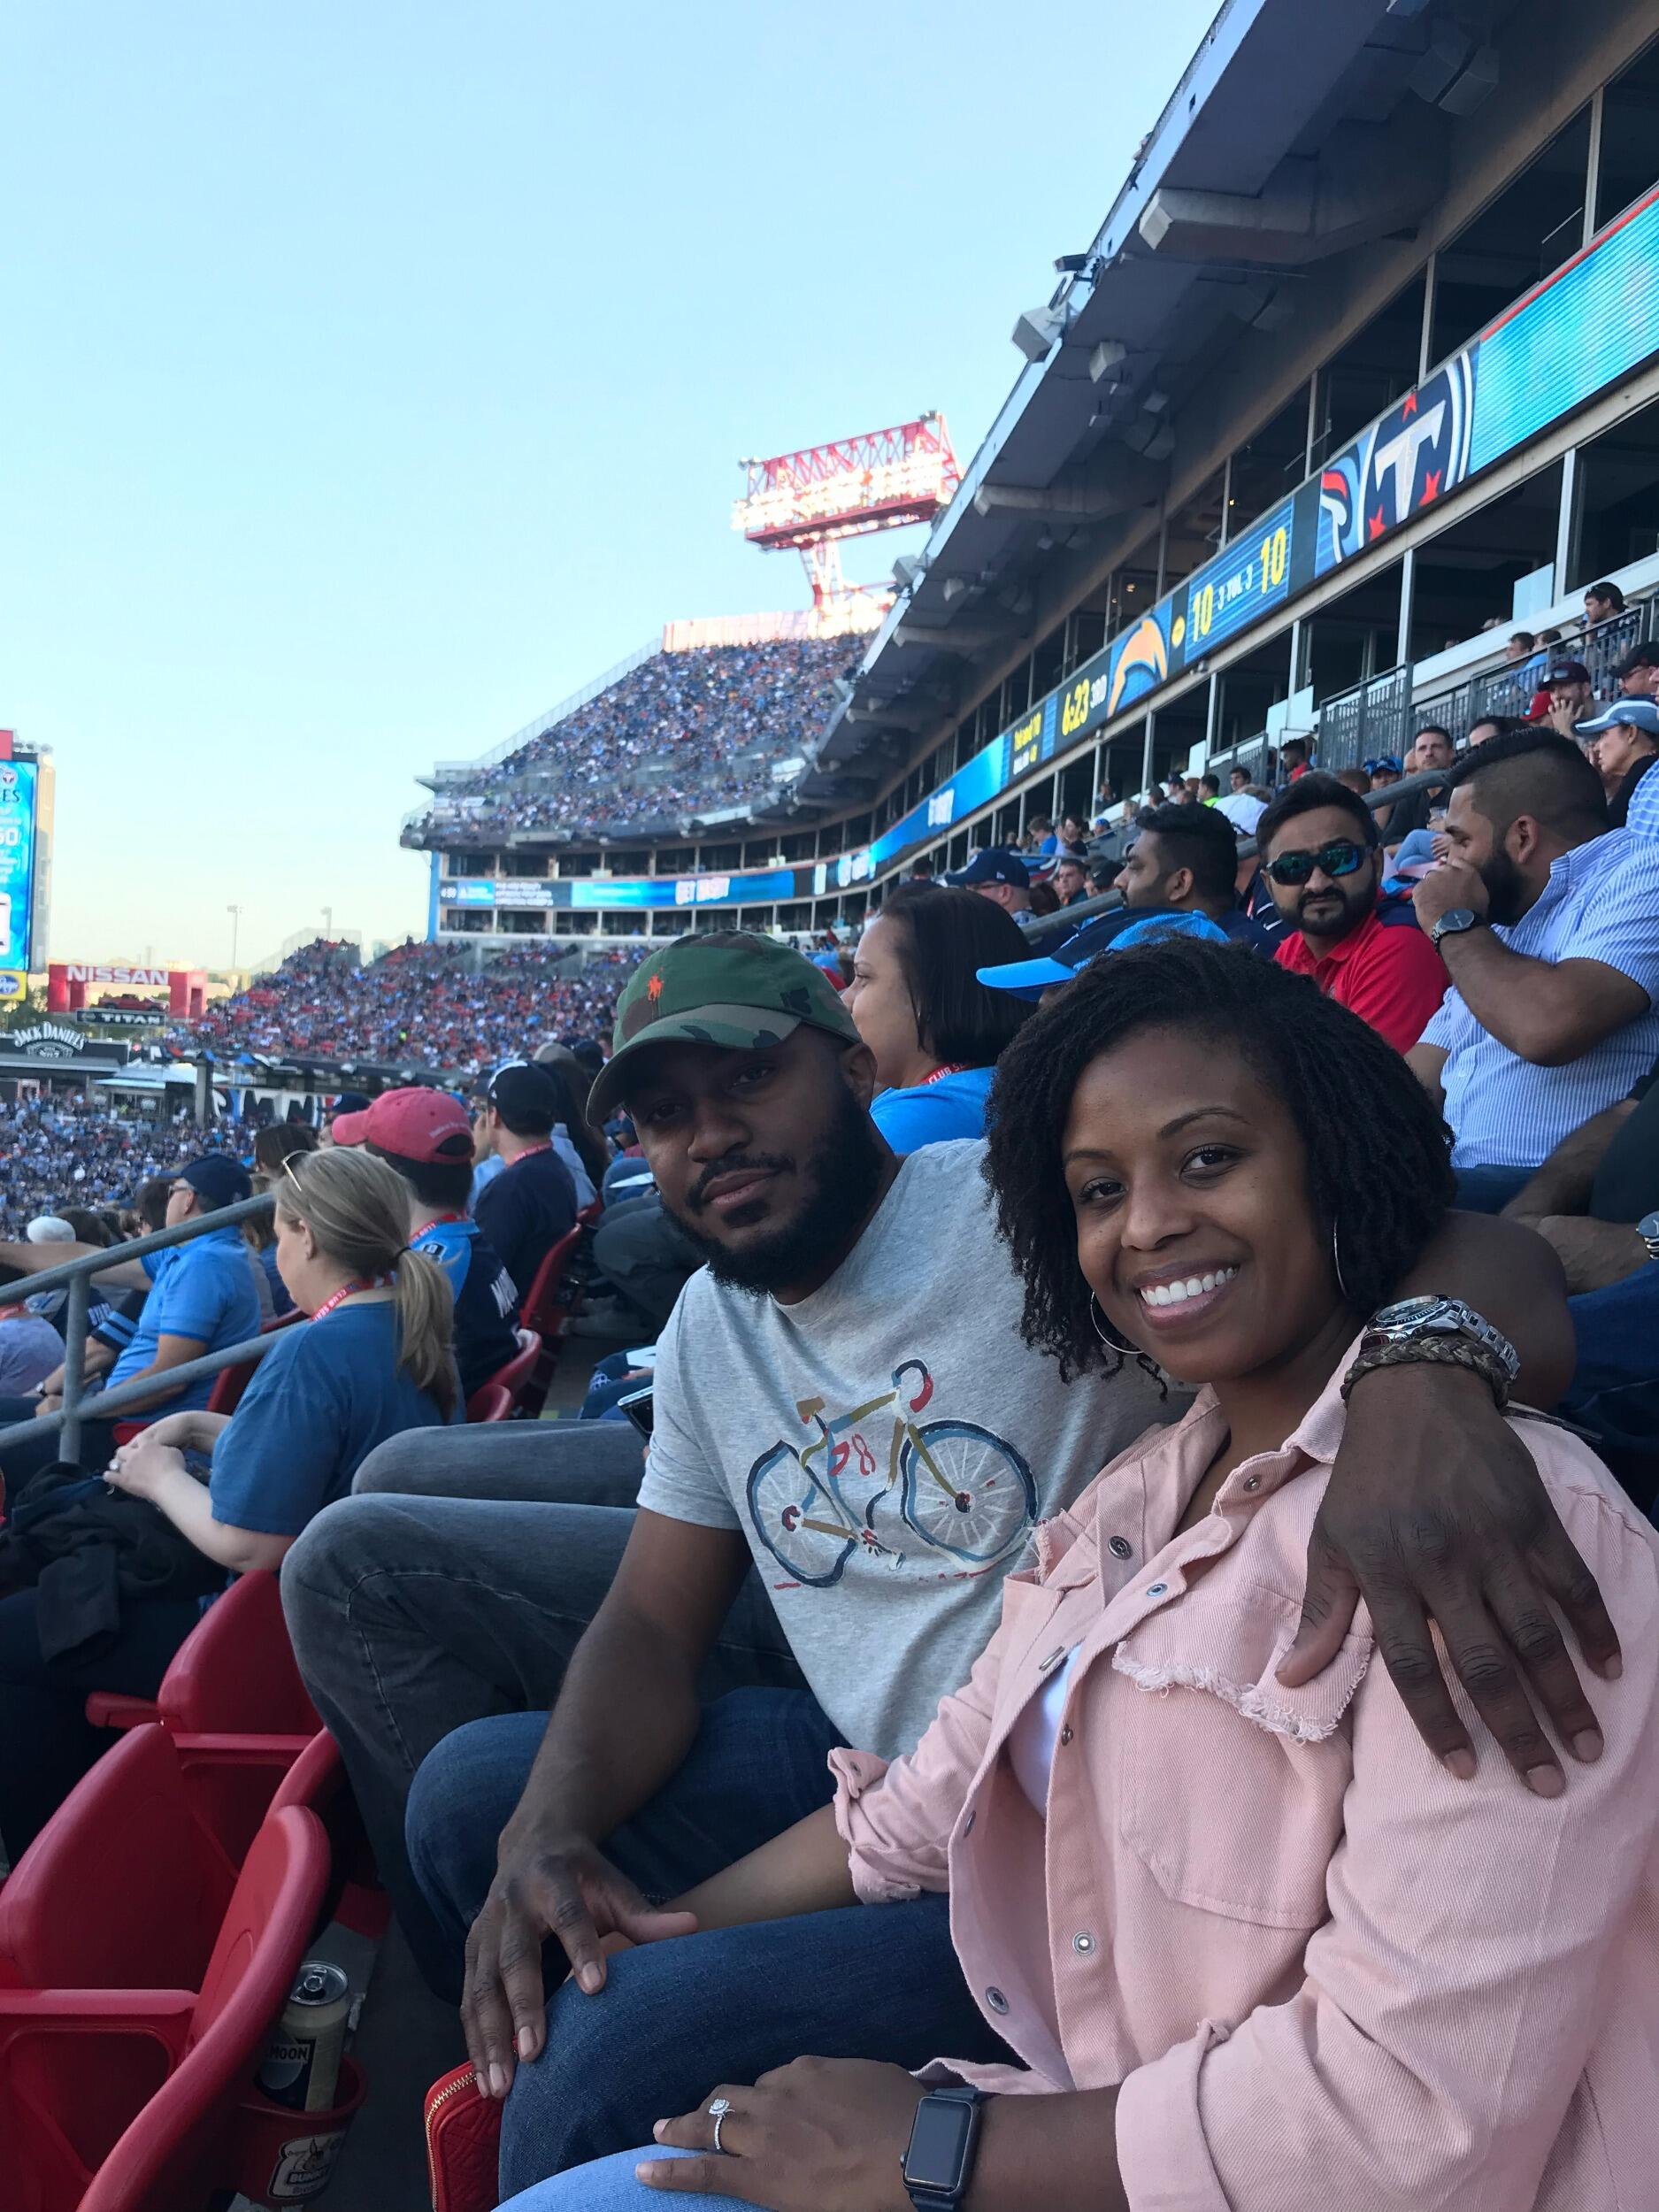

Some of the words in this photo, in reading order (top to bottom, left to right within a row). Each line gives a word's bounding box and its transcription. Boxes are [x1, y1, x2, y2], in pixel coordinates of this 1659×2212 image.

[1193, 583, 1213, 643] 10
[1260, 526, 1286, 595] 10
[1062, 678, 1090, 736] 6:23
[67, 965, 169, 985] NISSAN
[102, 1013, 160, 1025] TITAN
[14, 1026, 42, 1048] JACK
[42, 1021, 85, 1052] DANIEL'S
[928, 1066, 952, 1085] CLUB
[269, 2045, 309, 2061] MOON
